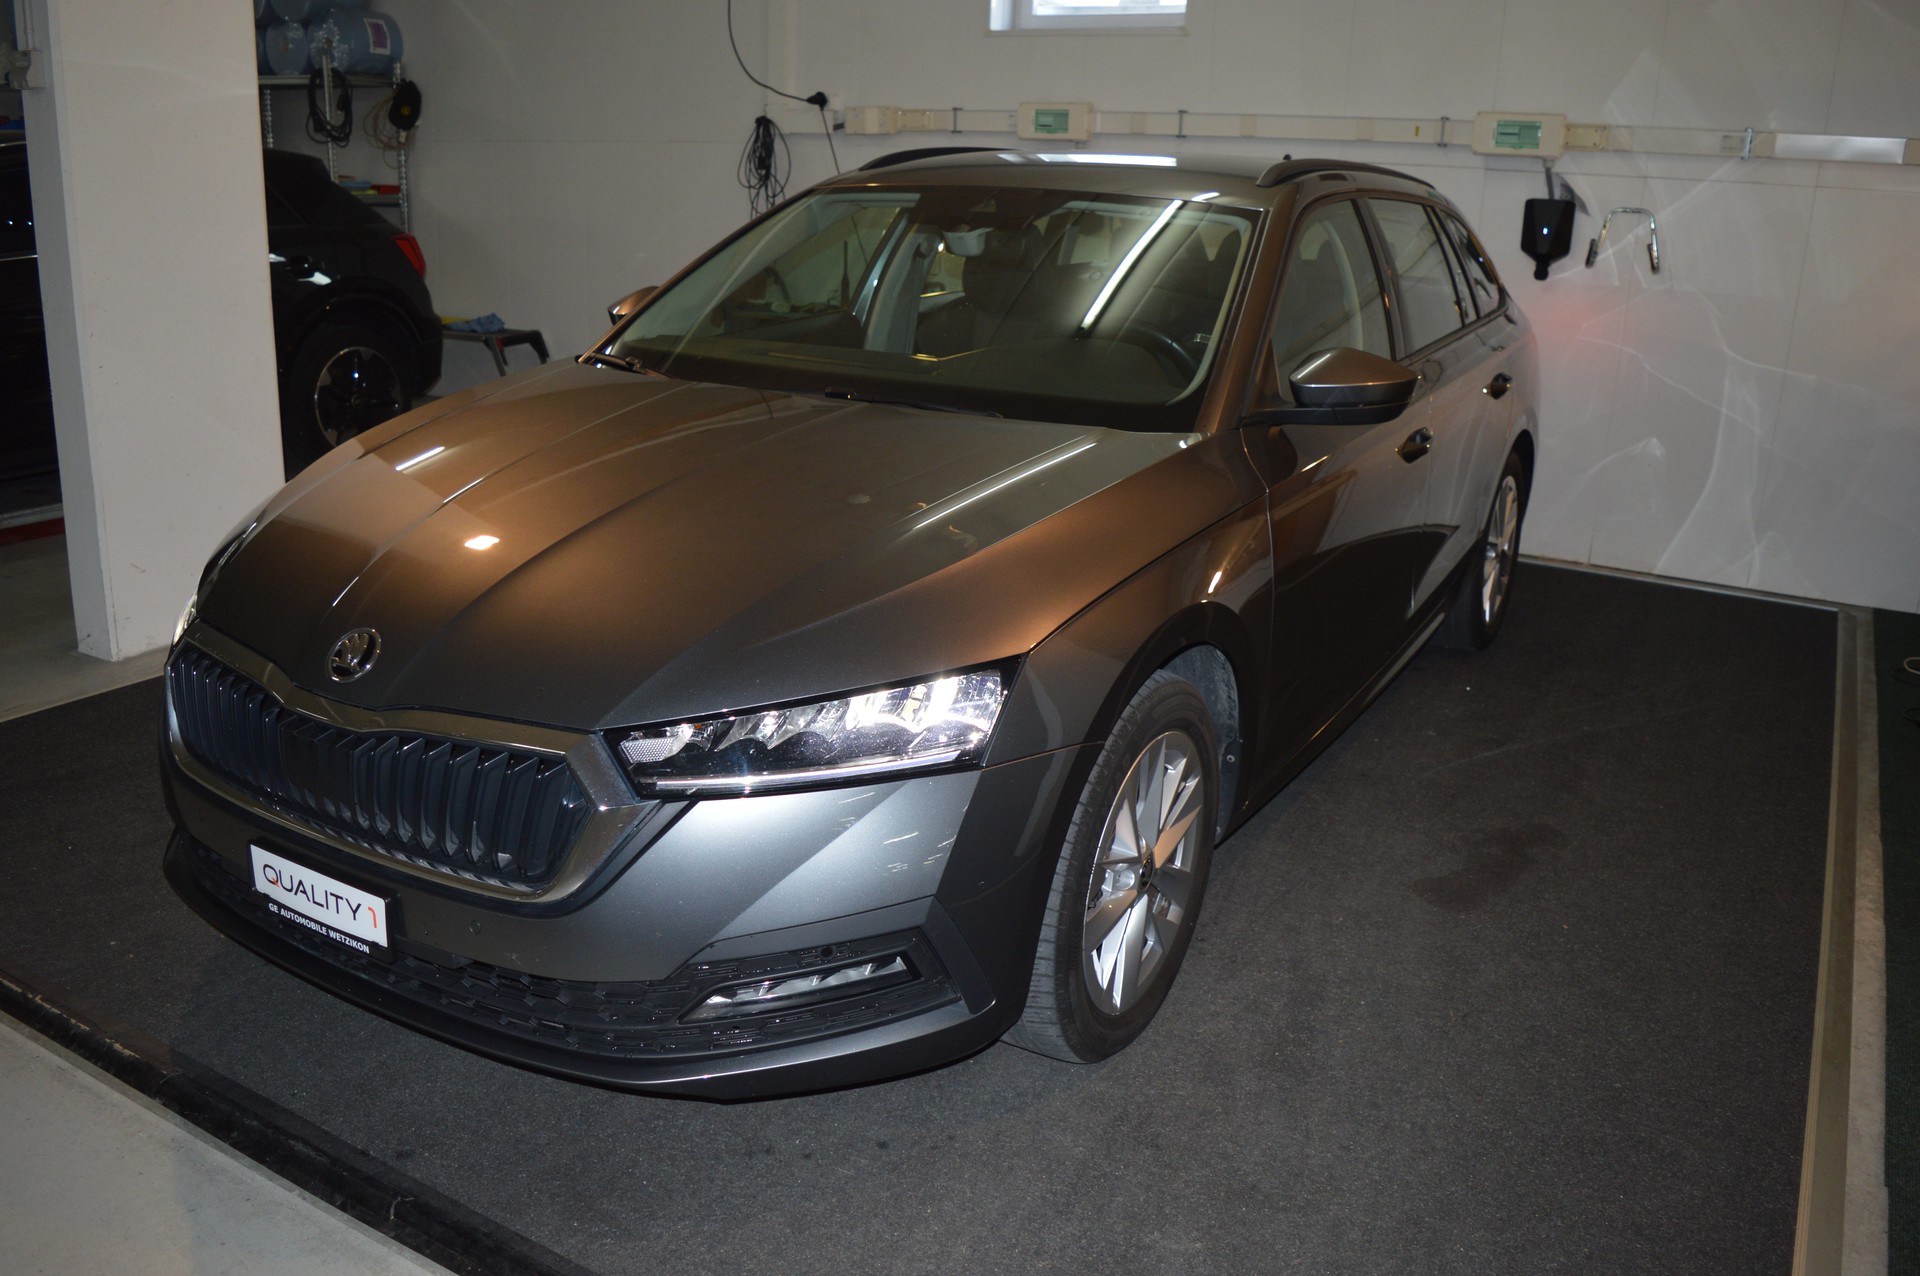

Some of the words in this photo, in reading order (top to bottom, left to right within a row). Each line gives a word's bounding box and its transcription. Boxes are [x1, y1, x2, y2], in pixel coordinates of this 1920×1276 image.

[268, 903, 279, 913] GE
[280, 908, 327, 934] AUTOMOBILE
[328, 929, 370, 954] WETZIKON
